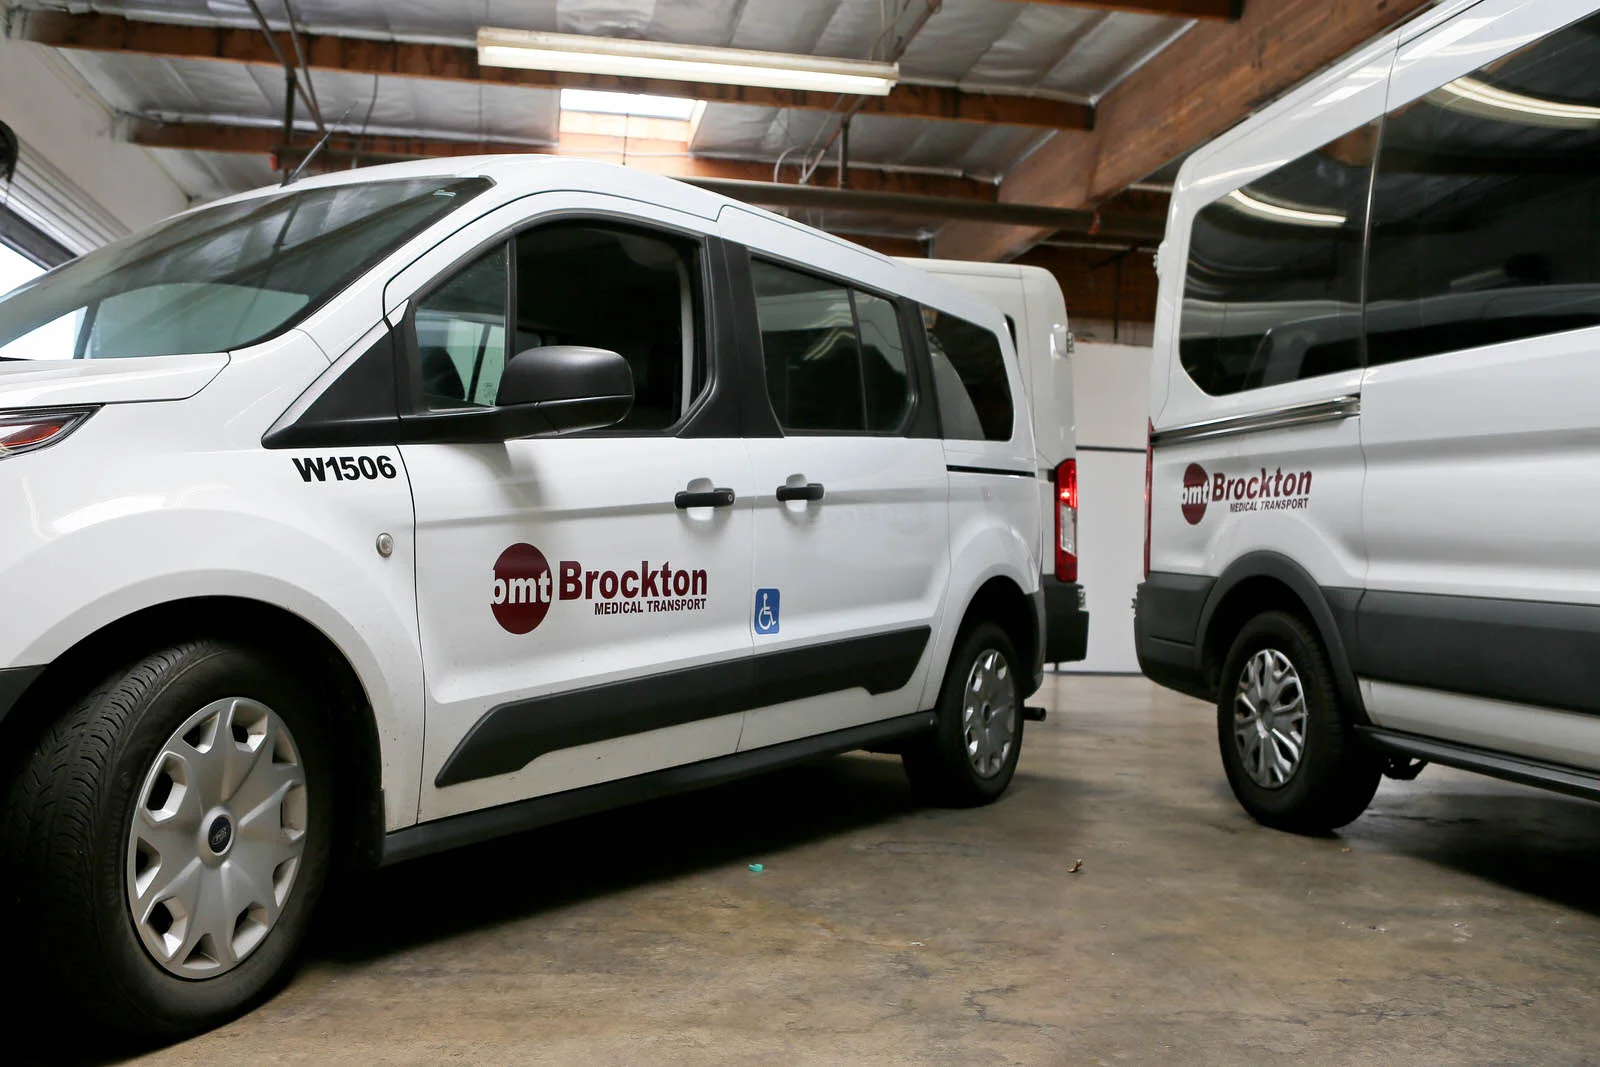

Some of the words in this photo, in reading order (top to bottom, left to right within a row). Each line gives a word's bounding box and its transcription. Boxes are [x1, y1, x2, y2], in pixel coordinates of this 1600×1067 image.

[291, 455, 397, 482] W1506
[1211, 467, 1312, 502] Brockton
[1229, 501, 1258, 513] MEDICAL
[1260, 498, 1309, 511] TRANSPORT
[489, 569, 551, 605] bmt
[559, 560, 708, 601] Brockton
[594, 601, 644, 615] MEDICAL
[647, 598, 707, 613] TRANSPORT
